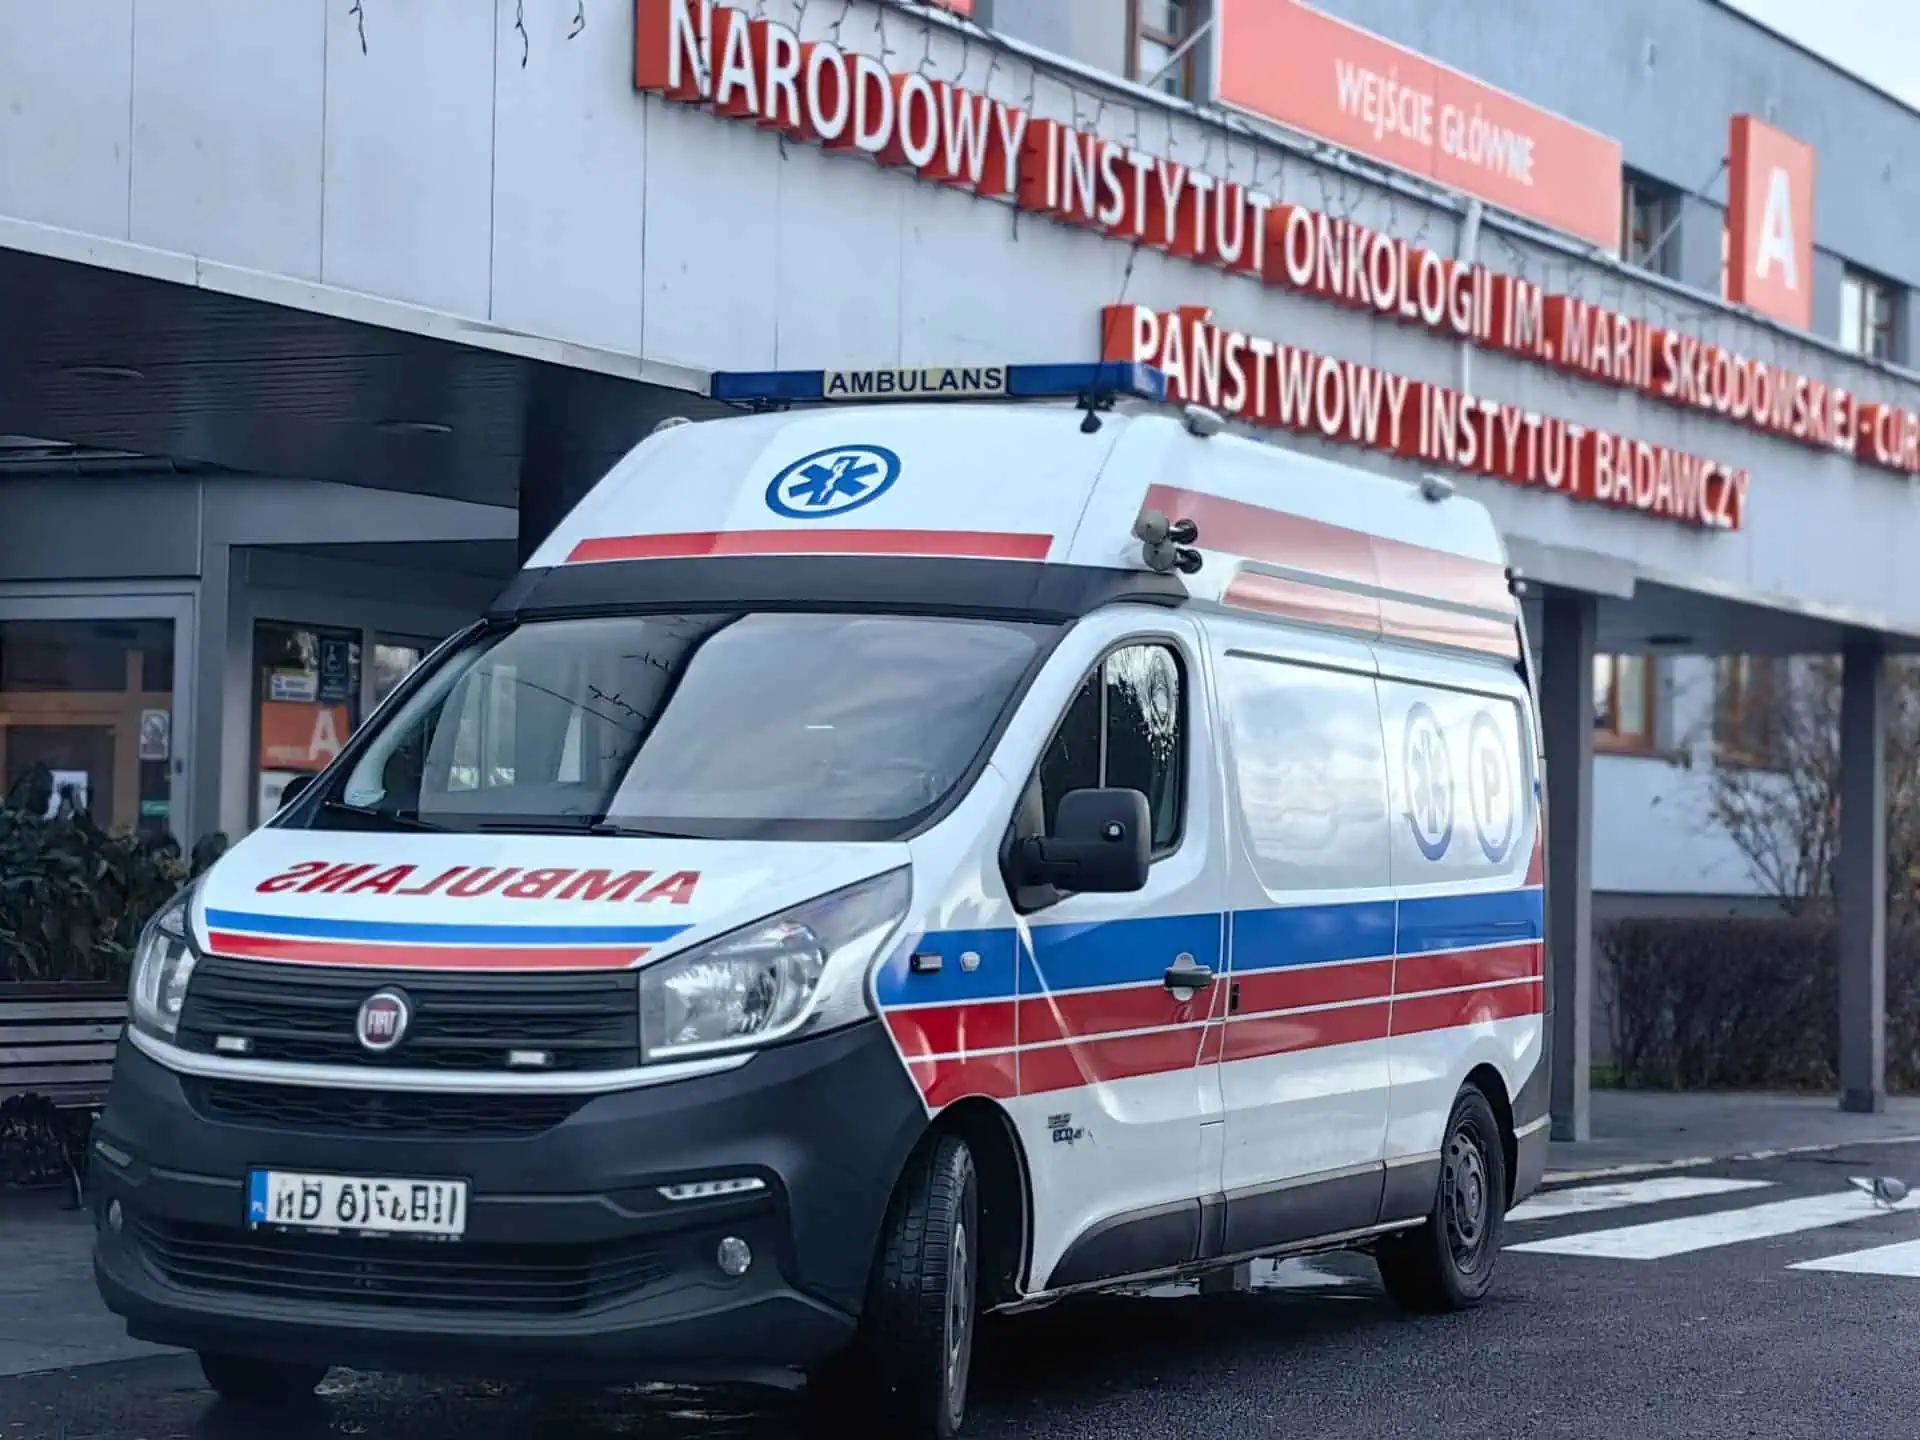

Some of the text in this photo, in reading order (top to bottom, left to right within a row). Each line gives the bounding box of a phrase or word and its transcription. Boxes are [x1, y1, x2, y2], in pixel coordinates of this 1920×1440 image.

[1334, 58, 1536, 187] WEJŚCIE GŁÓWNE
[668, 0, 1027, 193] NARODOWY
[1046, 119, 1272, 270] INSTYTUT
[1284, 205, 1493, 340] ONKOLOGII
[1503, 276, 1553, 361] IM.
[1560, 296, 1651, 389] MARII
[1755, 166, 1798, 291] A
[827, 367, 1003, 395] AMBULANS
[1133, 304, 1749, 532] PAŃSTWOWY INSTYTUT BADAWCZY
[308, 708, 342, 761] A
[1480, 746, 1501, 825] P
